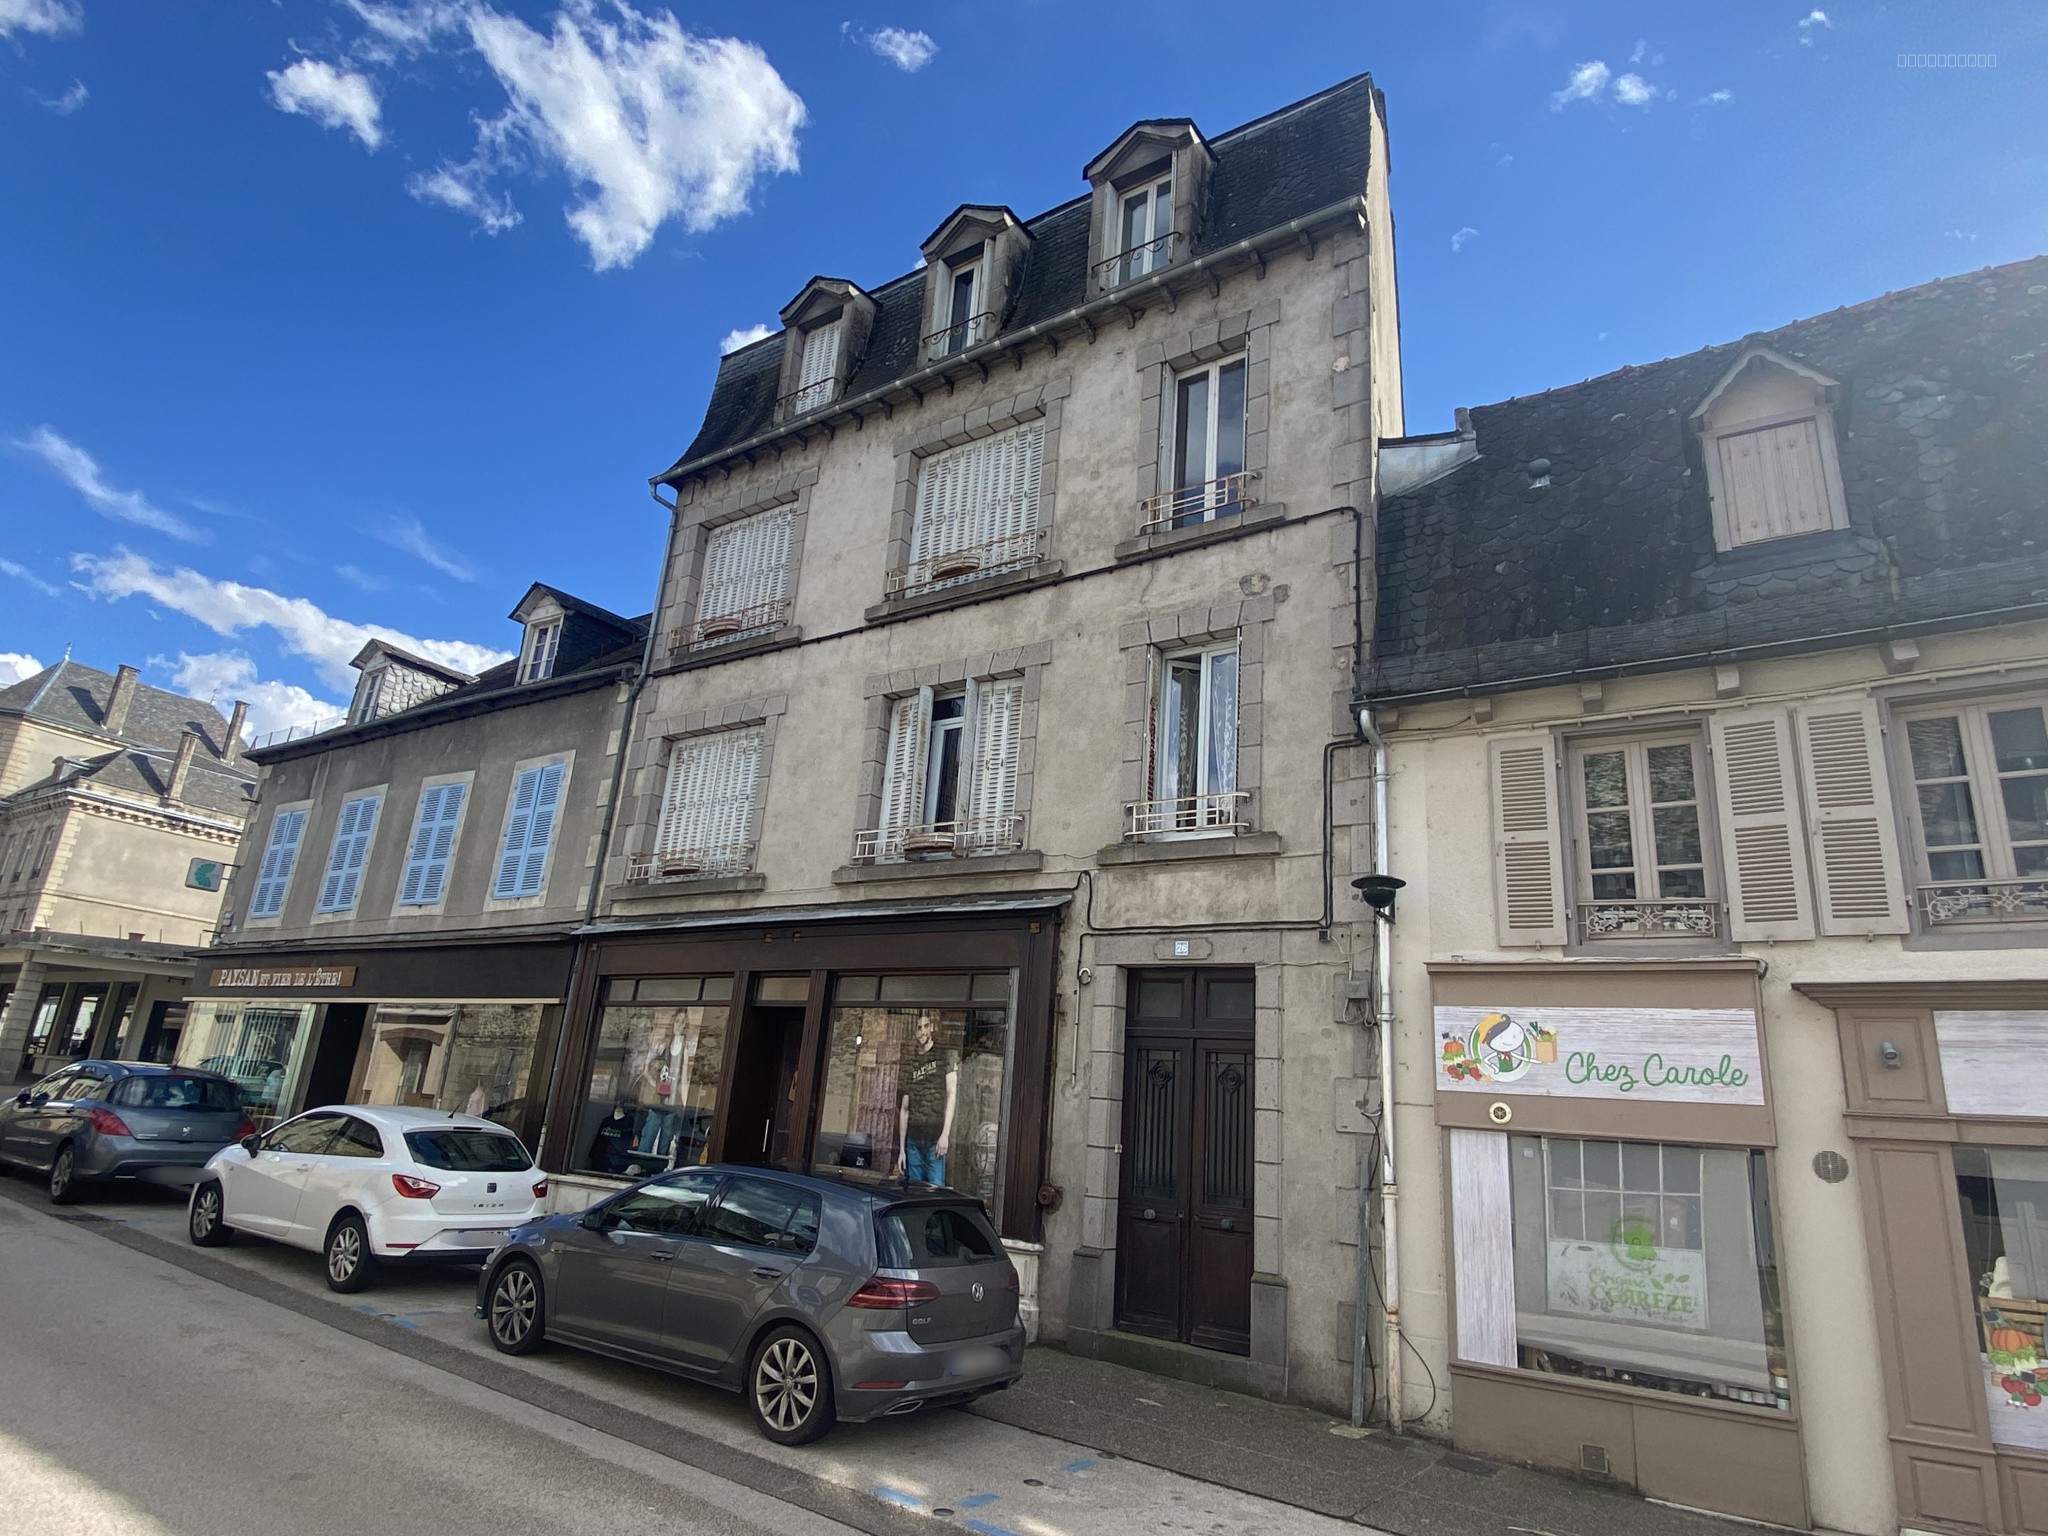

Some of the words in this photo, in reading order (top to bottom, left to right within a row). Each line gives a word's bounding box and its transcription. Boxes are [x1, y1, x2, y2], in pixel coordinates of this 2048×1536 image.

[1177, 944, 1187, 953] 26
[218, 969, 260, 987] PAYSAN
[259, 973, 271, 986] ET
[293, 973, 306, 986] DE
[1565, 1051, 1639, 1092] Chez
[1643, 1053, 1749, 1087] Carole
